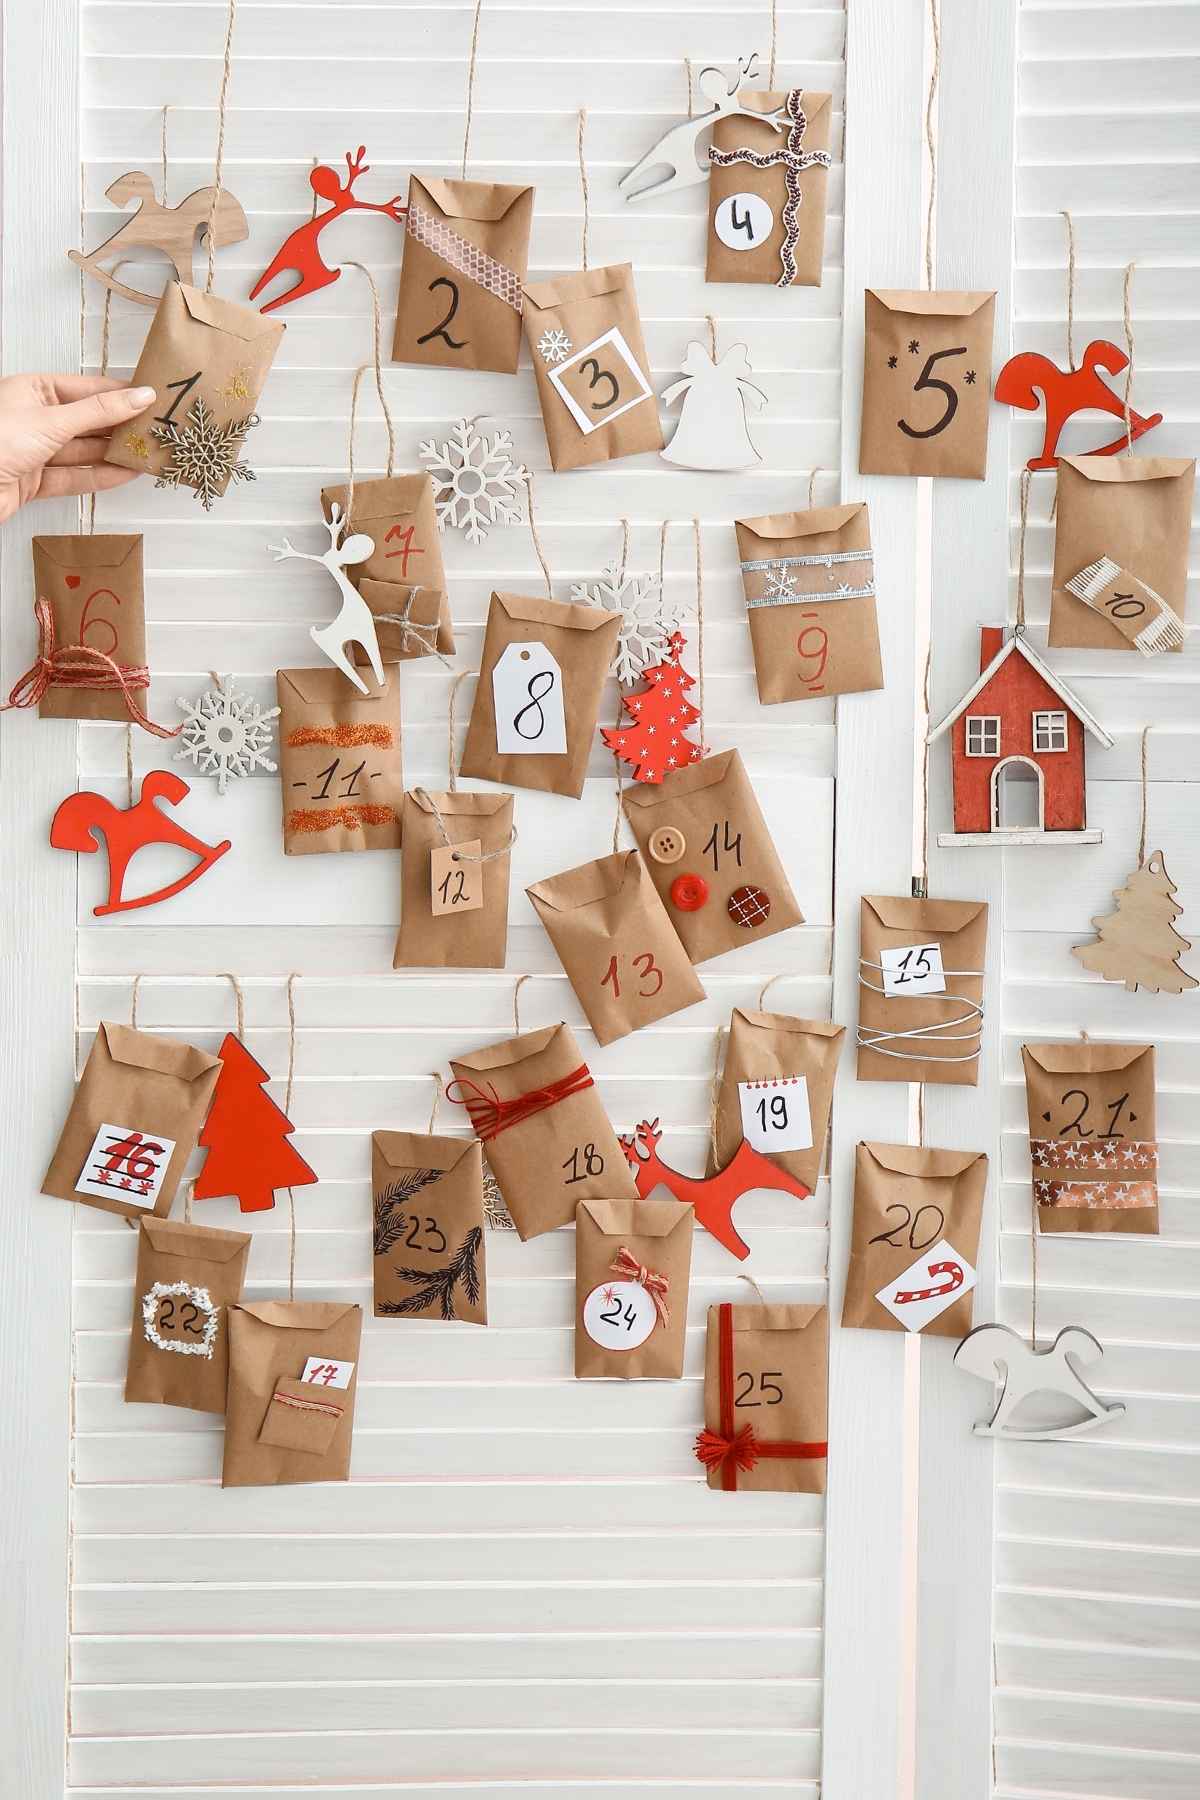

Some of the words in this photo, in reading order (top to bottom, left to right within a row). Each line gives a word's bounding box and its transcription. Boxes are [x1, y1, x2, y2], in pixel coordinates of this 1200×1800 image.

[731, 199, 755, 241] 4
[416, 276, 470, 349] 2
[153, 370, 203, 427] 1
[578, 357, 621, 410] 3
[897, 346, 968, 439] 5
[384, 524, 426, 578] 7
[80, 587, 121, 658] 6
[1104, 591, 1146, 619] 10
[513, 671, 554, 740] 8
[701, 820, 743, 872] 14
[437, 869, 470, 905] 12
[600, 951, 664, 998] 13
[894, 947, 939, 986] 15
[754, 1094, 789, 1132] 19
[1058, 1089, 1130, 1139] 21
[104, 1132, 167, 1179] 16
[562, 1142, 605, 1185] 18
[405, 1215, 447, 1253] 23
[867, 1203, 945, 1250] 20
[159, 1298, 203, 1335] 22
[599, 1297, 637, 1332] 24
[309, 1363, 339, 1387] 17
[733, 1371, 783, 1408] 25
